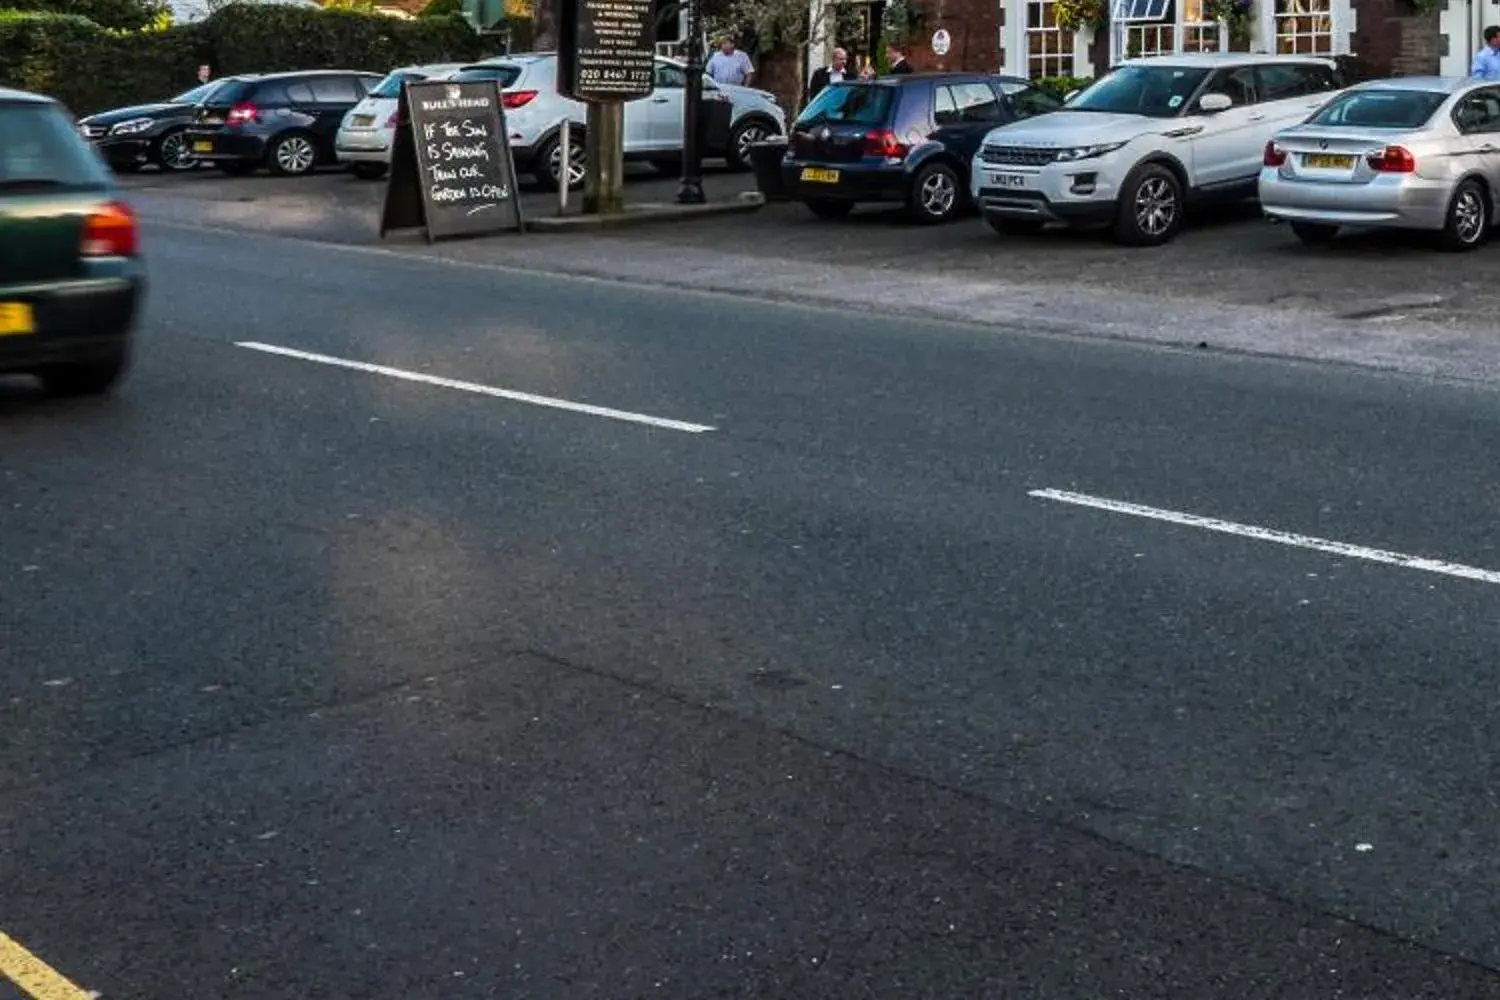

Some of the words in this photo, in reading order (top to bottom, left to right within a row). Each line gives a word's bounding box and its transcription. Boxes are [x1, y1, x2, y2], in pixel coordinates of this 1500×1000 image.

[580, 69, 601, 79] 020
[461, 119, 488, 137] SUN
[427, 143, 441, 159] IS
[481, 183, 509, 199] OPEN
